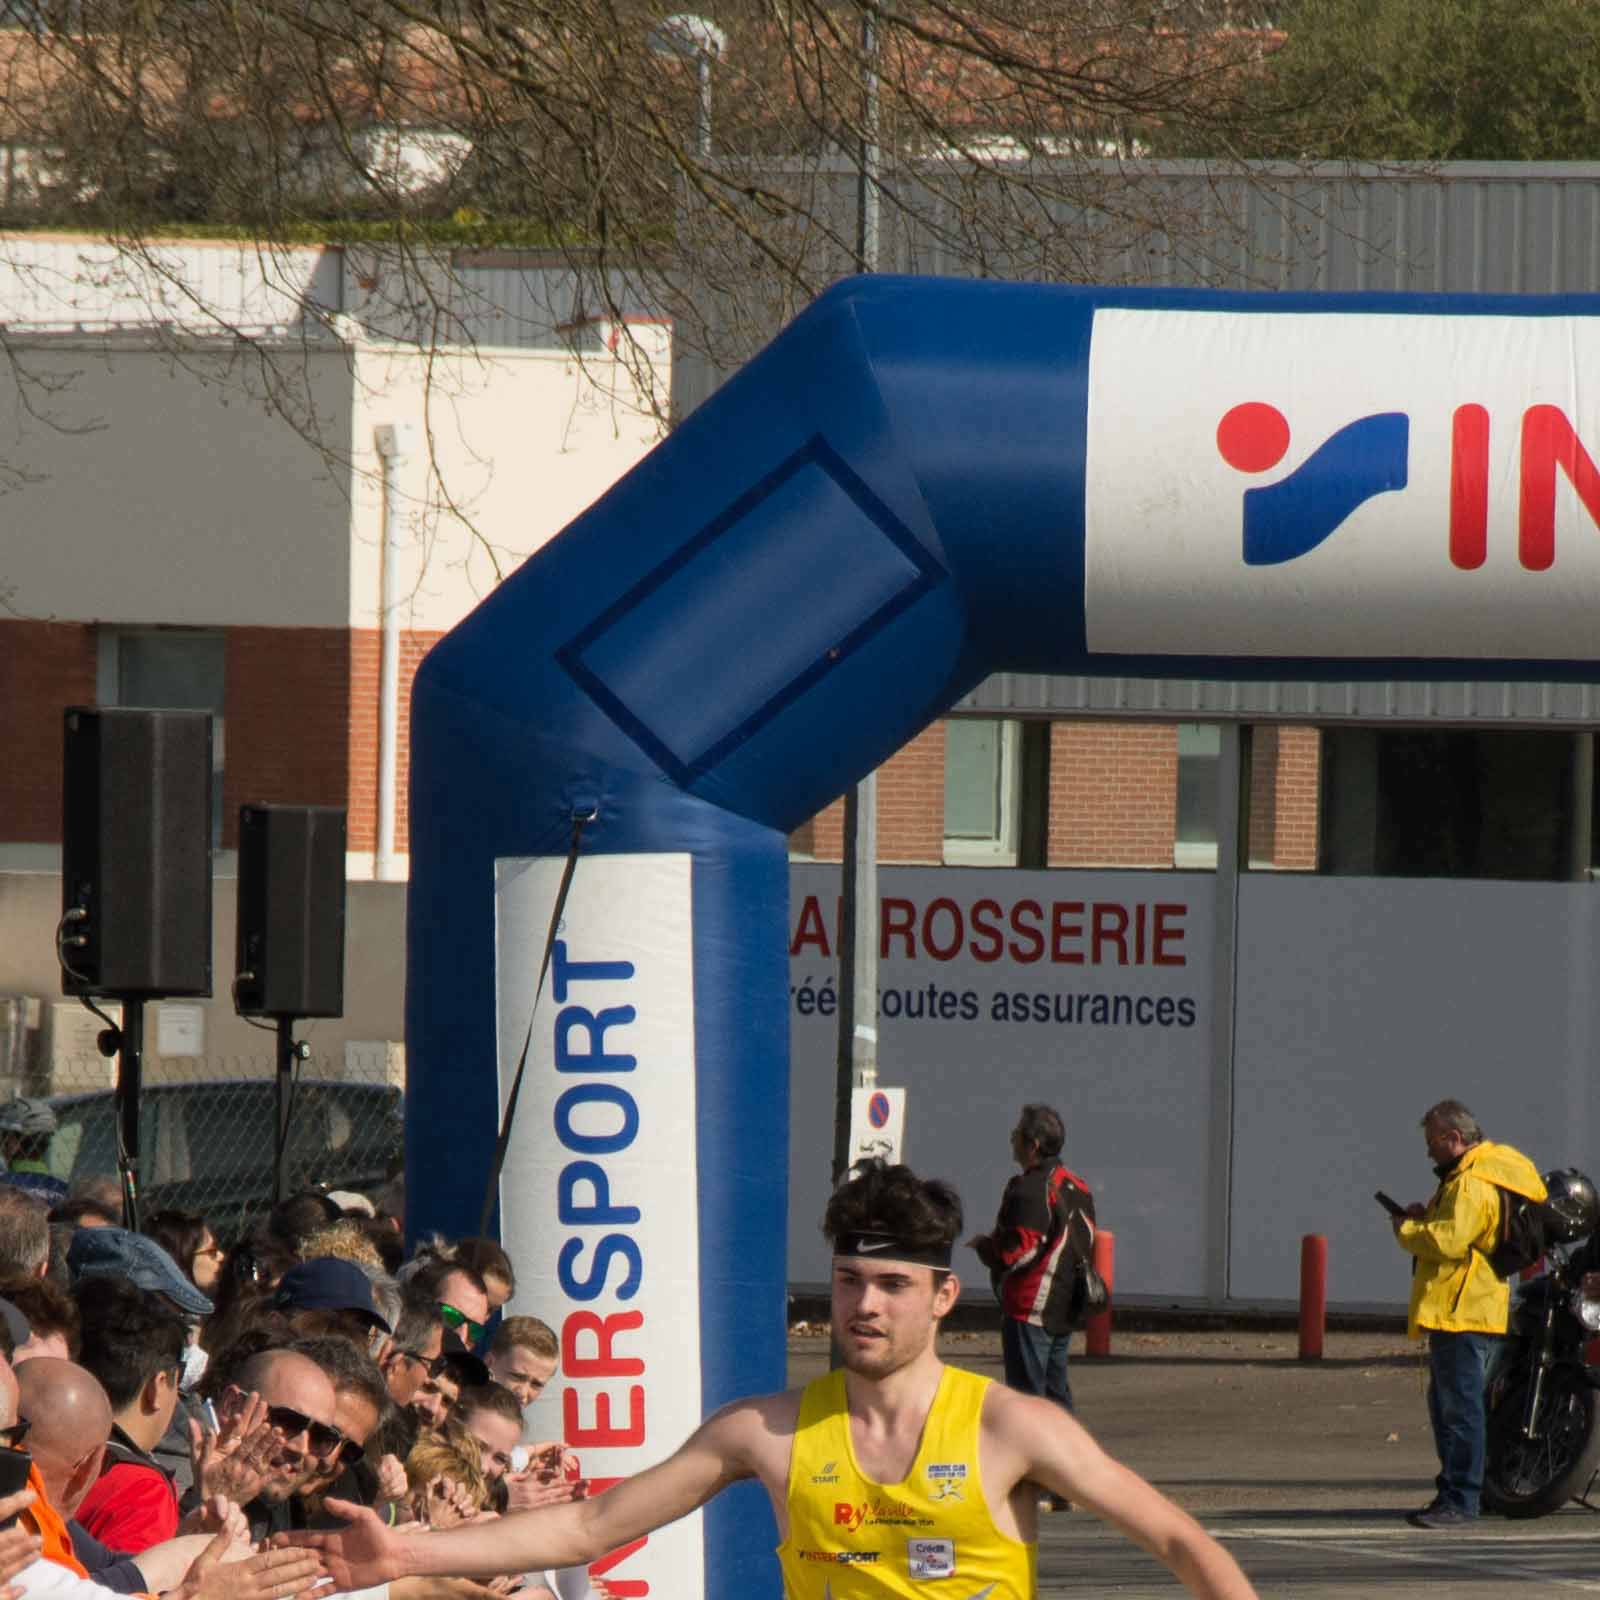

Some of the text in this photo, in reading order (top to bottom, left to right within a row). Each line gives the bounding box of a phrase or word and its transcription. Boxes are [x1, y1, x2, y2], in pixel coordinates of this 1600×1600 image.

[789, 895, 1188, 966] AROSSERIE
[875, 982, 979, 1020] outes
[991, 987, 1196, 1027] assurances
[811, 1474, 841, 1485] START
